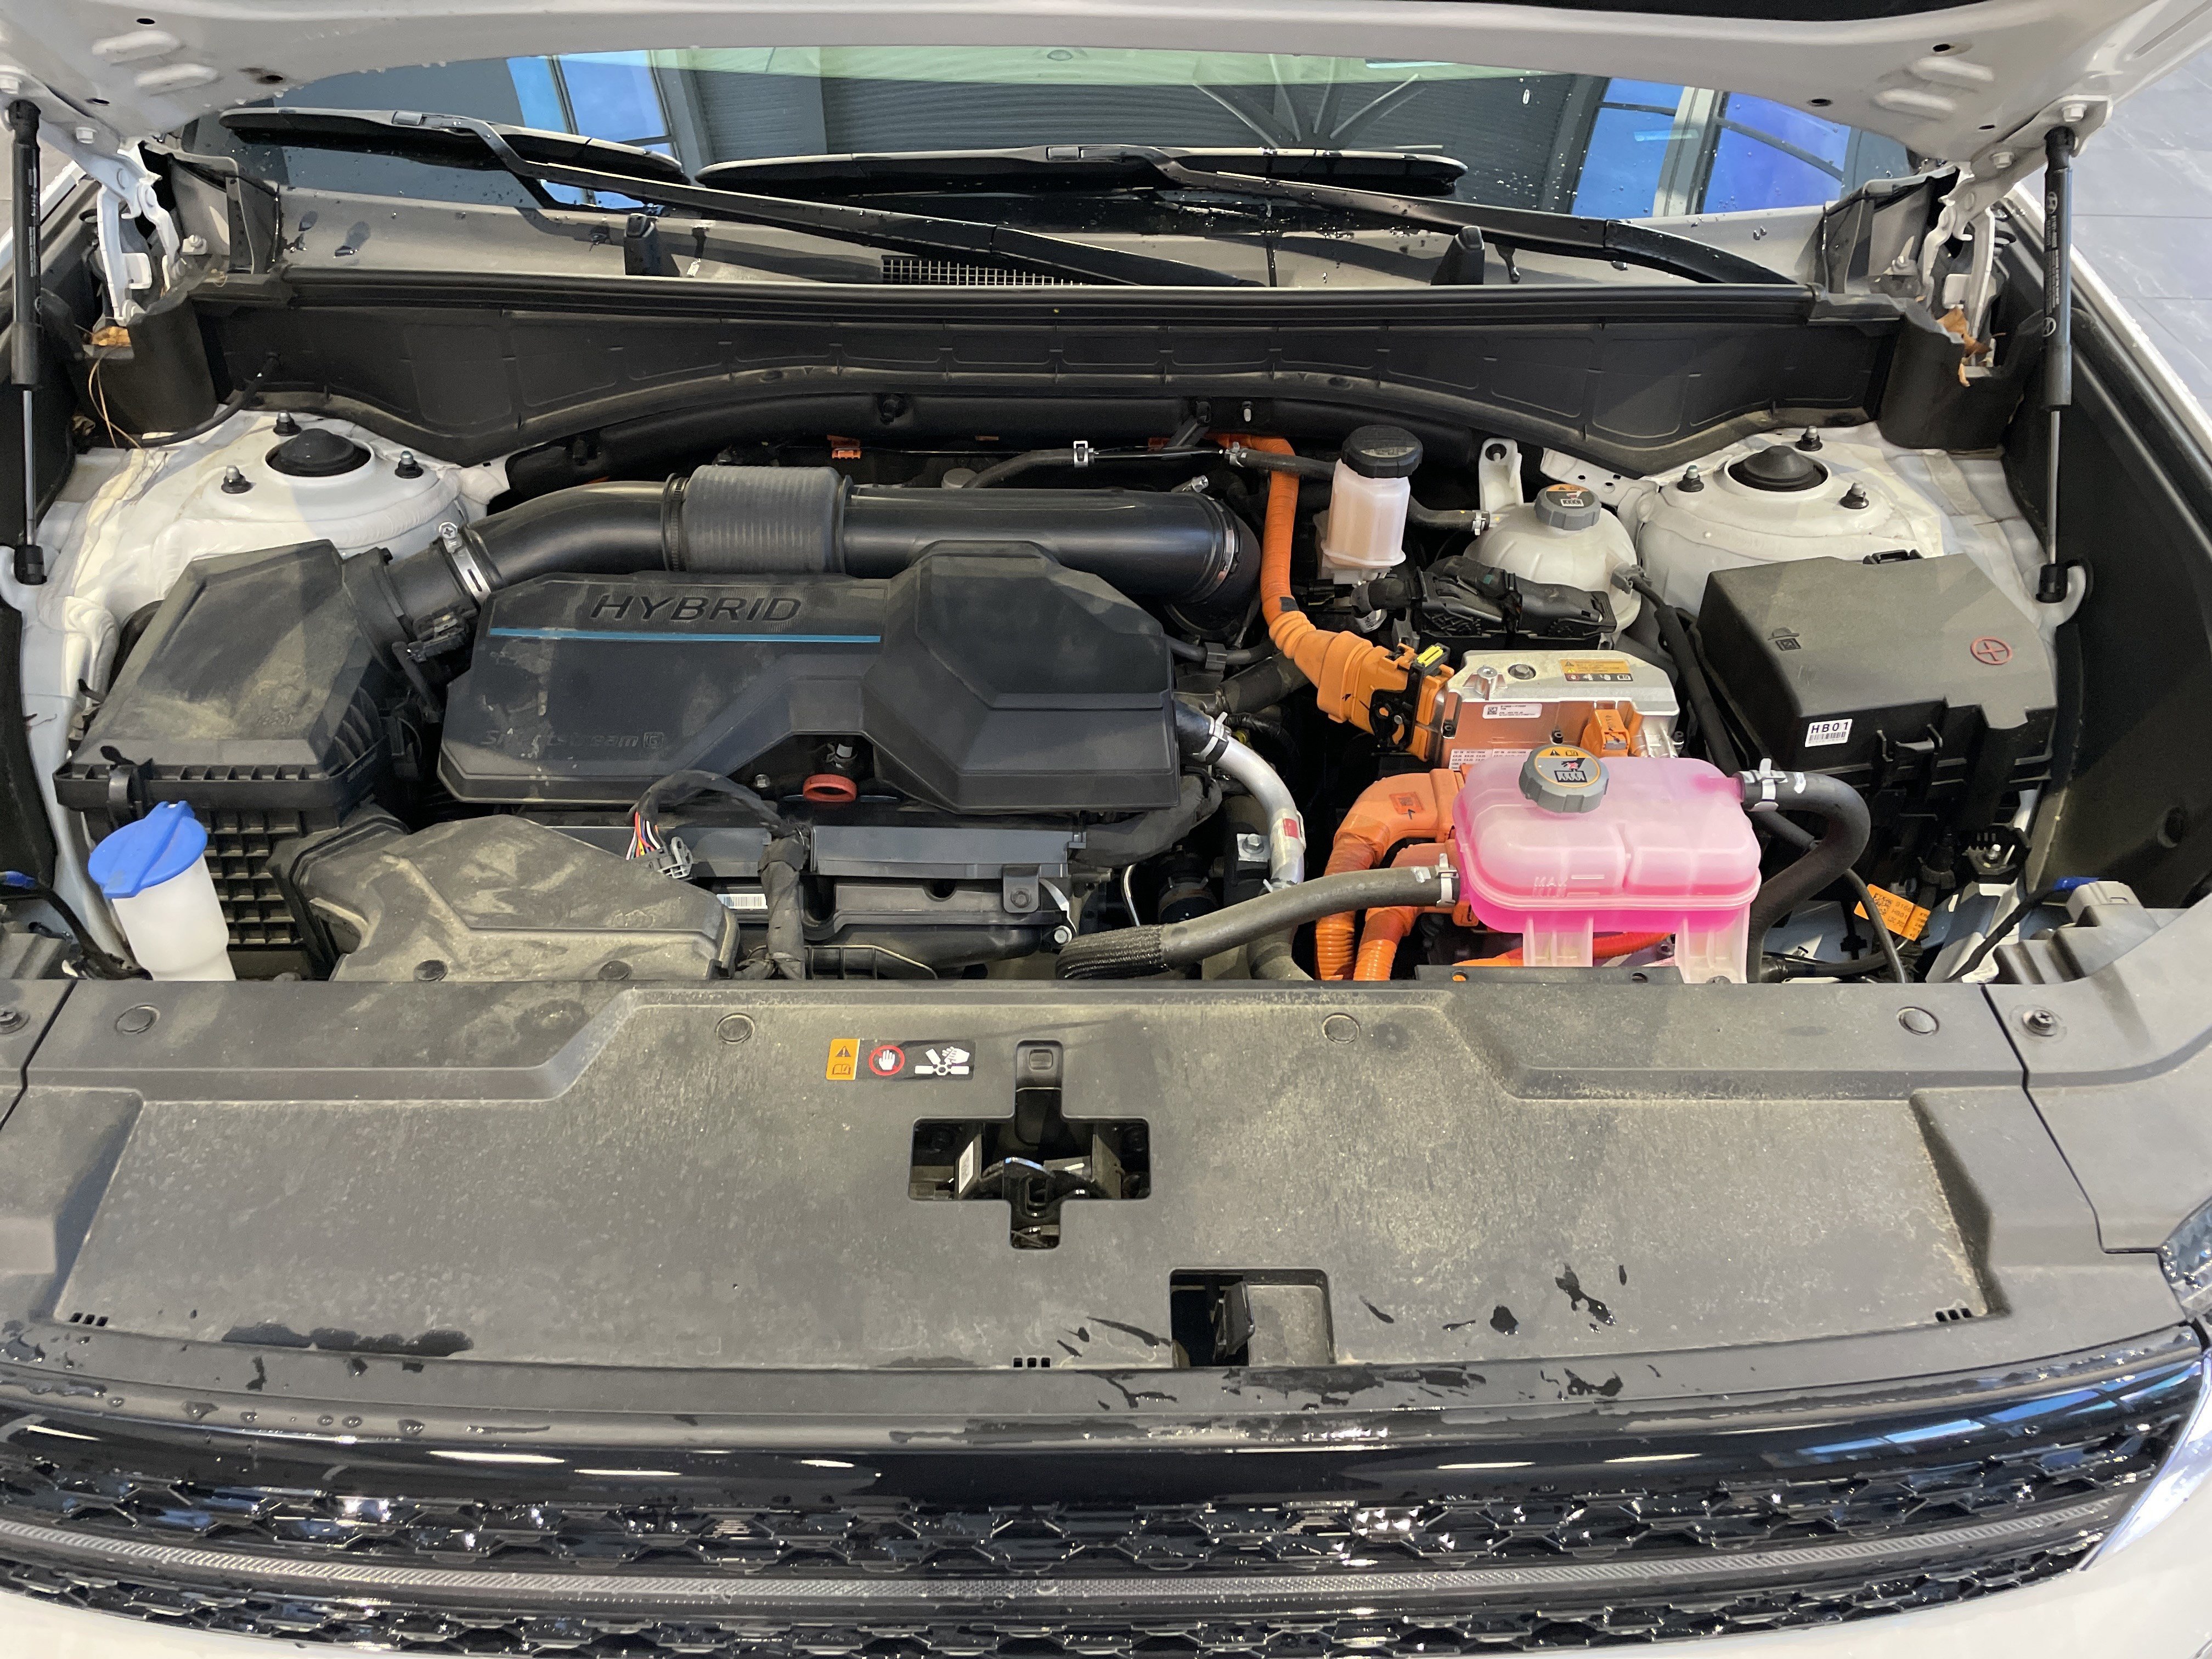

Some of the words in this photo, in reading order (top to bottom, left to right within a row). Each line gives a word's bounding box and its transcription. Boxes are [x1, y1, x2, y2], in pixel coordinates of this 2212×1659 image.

[590, 595, 801, 620] HYBRID
[1811, 722, 1848, 733] HB01
[482, 730, 639, 747] Smtstream
[1534, 877, 1567, 887] MAX
